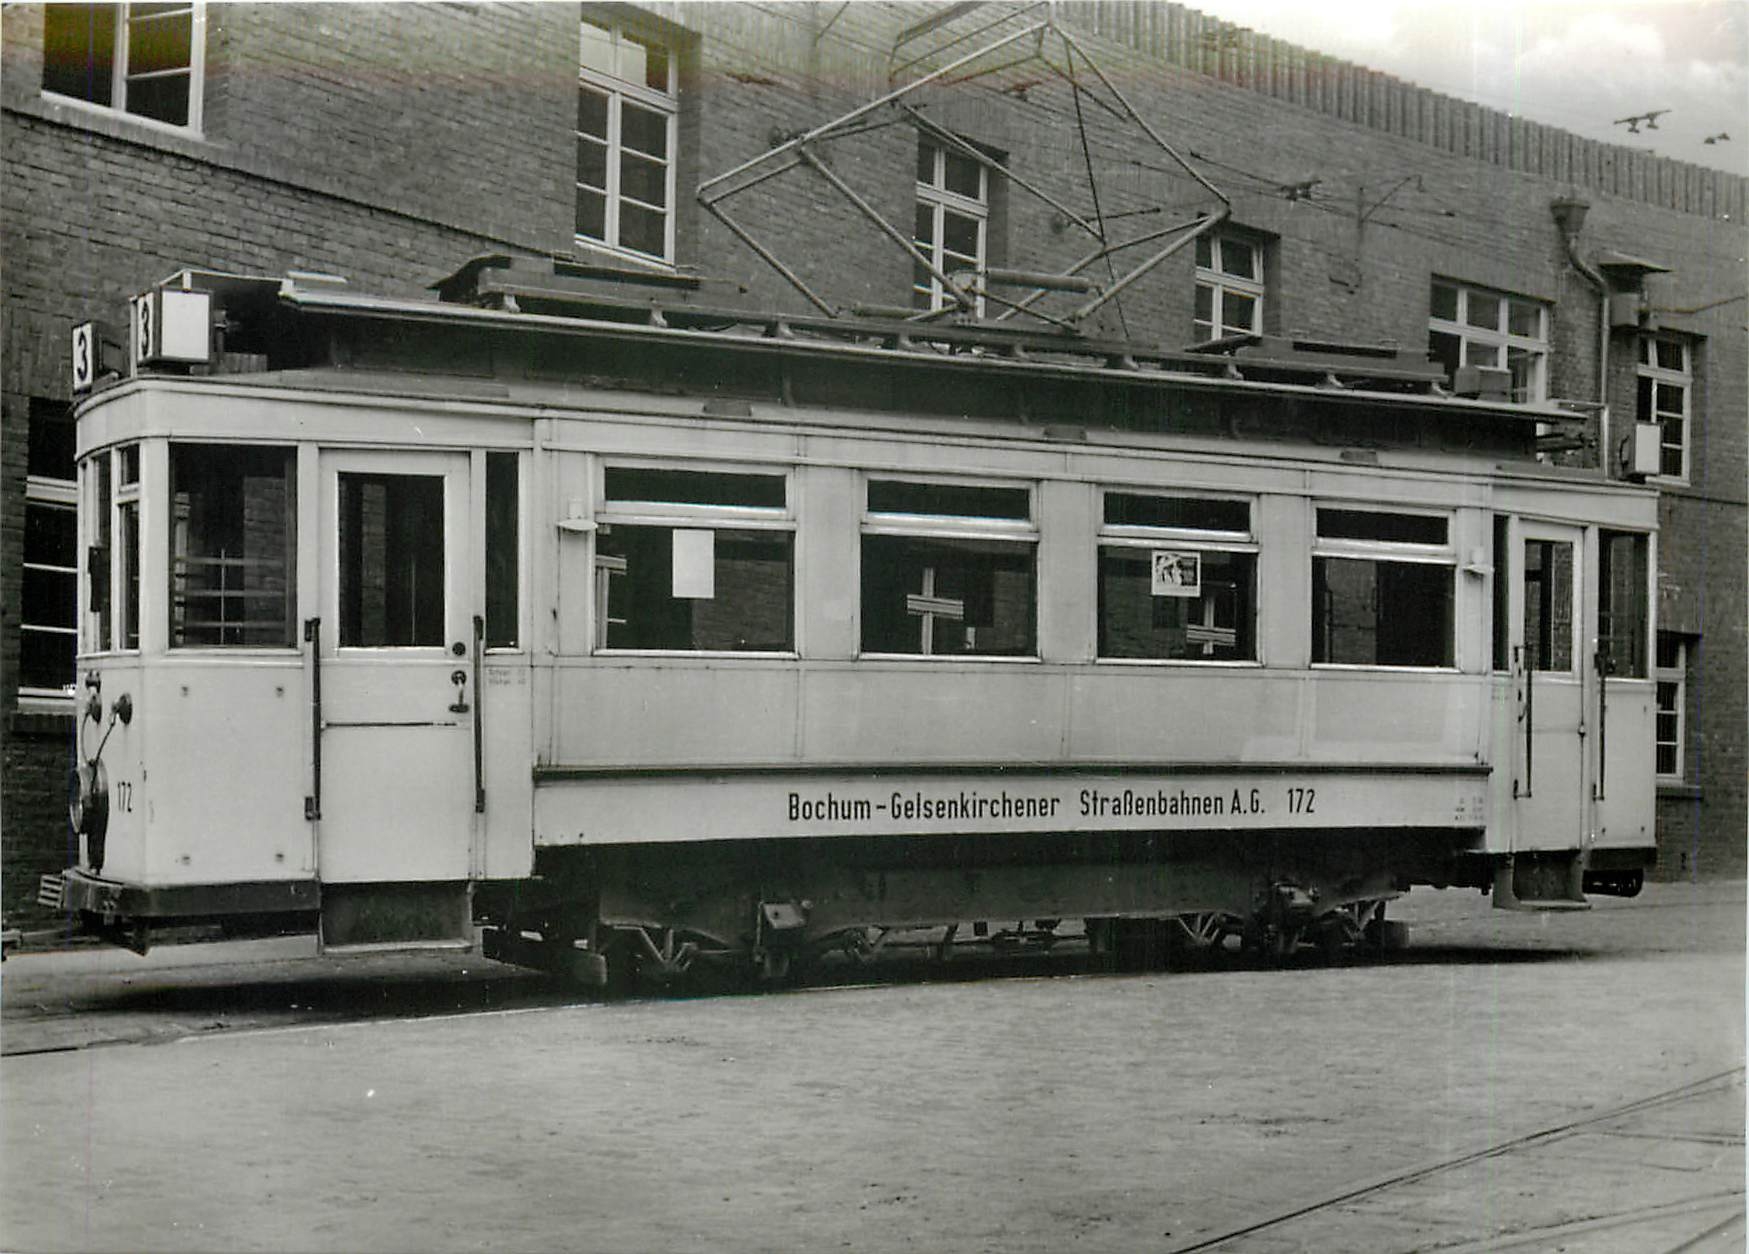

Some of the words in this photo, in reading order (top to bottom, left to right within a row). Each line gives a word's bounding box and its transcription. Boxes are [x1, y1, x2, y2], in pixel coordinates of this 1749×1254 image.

[141, 300, 149, 357] 3
[77, 331, 88, 382] 3
[117, 781, 132, 813] 172
[1079, 789, 1224, 817] Straßenbahnen
[1231, 788, 1266, 815] A.G.
[1287, 788, 1317, 814] 172
